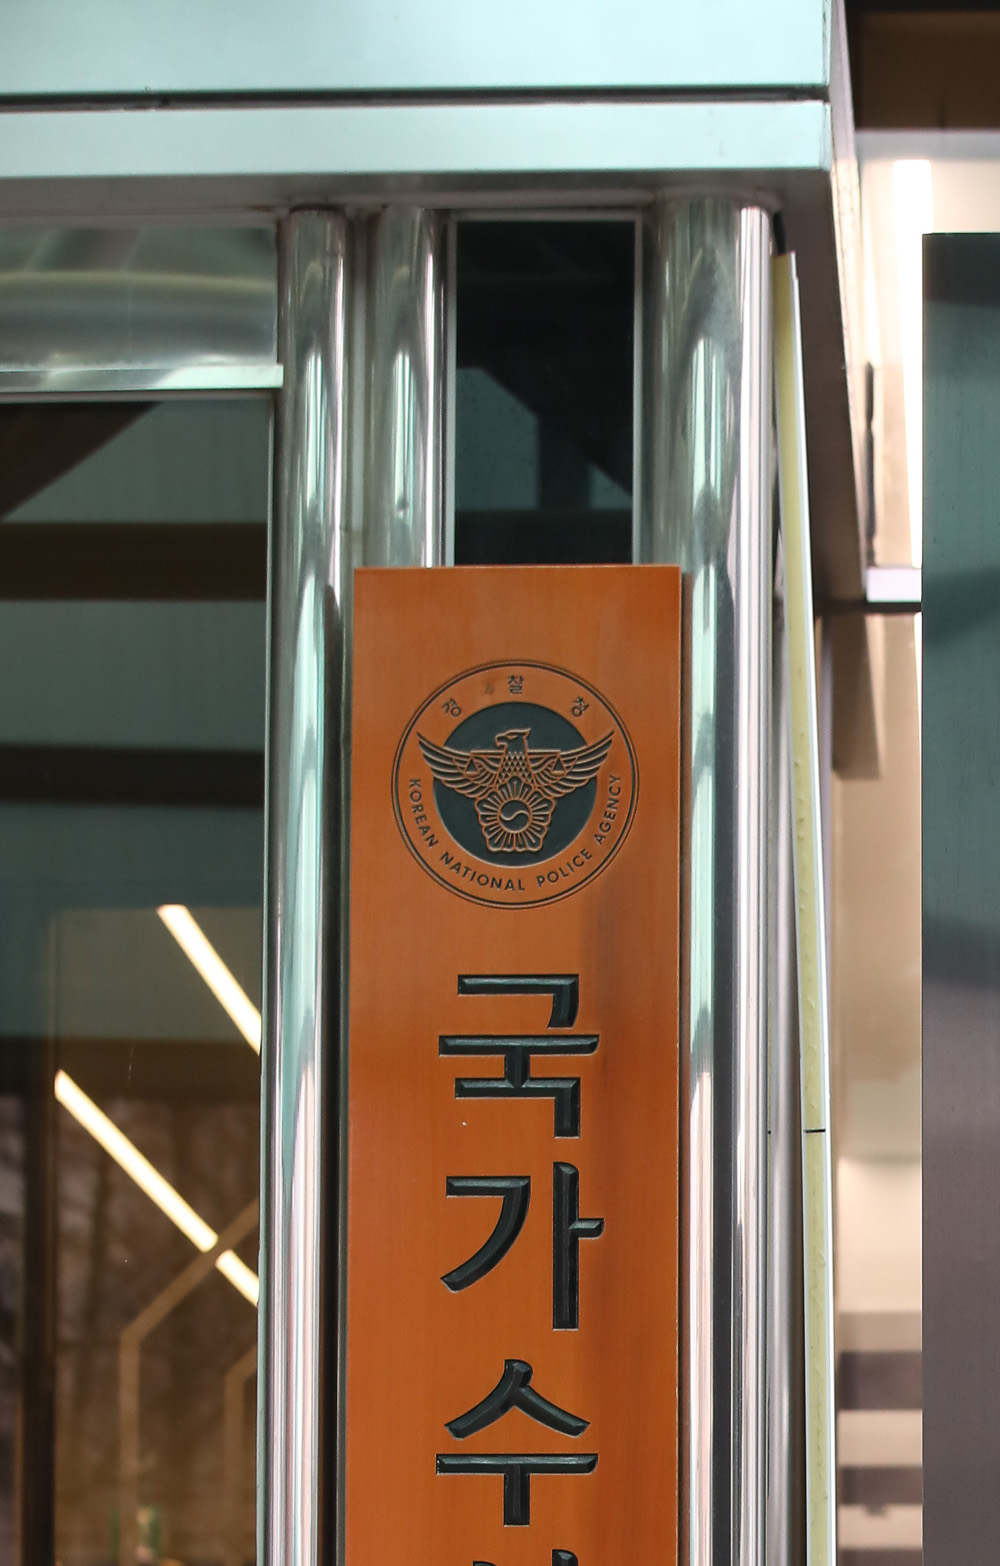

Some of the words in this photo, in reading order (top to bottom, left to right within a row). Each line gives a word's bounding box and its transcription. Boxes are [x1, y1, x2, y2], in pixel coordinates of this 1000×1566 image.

[409, 778, 439, 848] KOREAN
[439, 852, 526, 891] NATIONAL
[536, 848, 593, 888] POLICE
[593, 775, 622, 845] AGENCY
